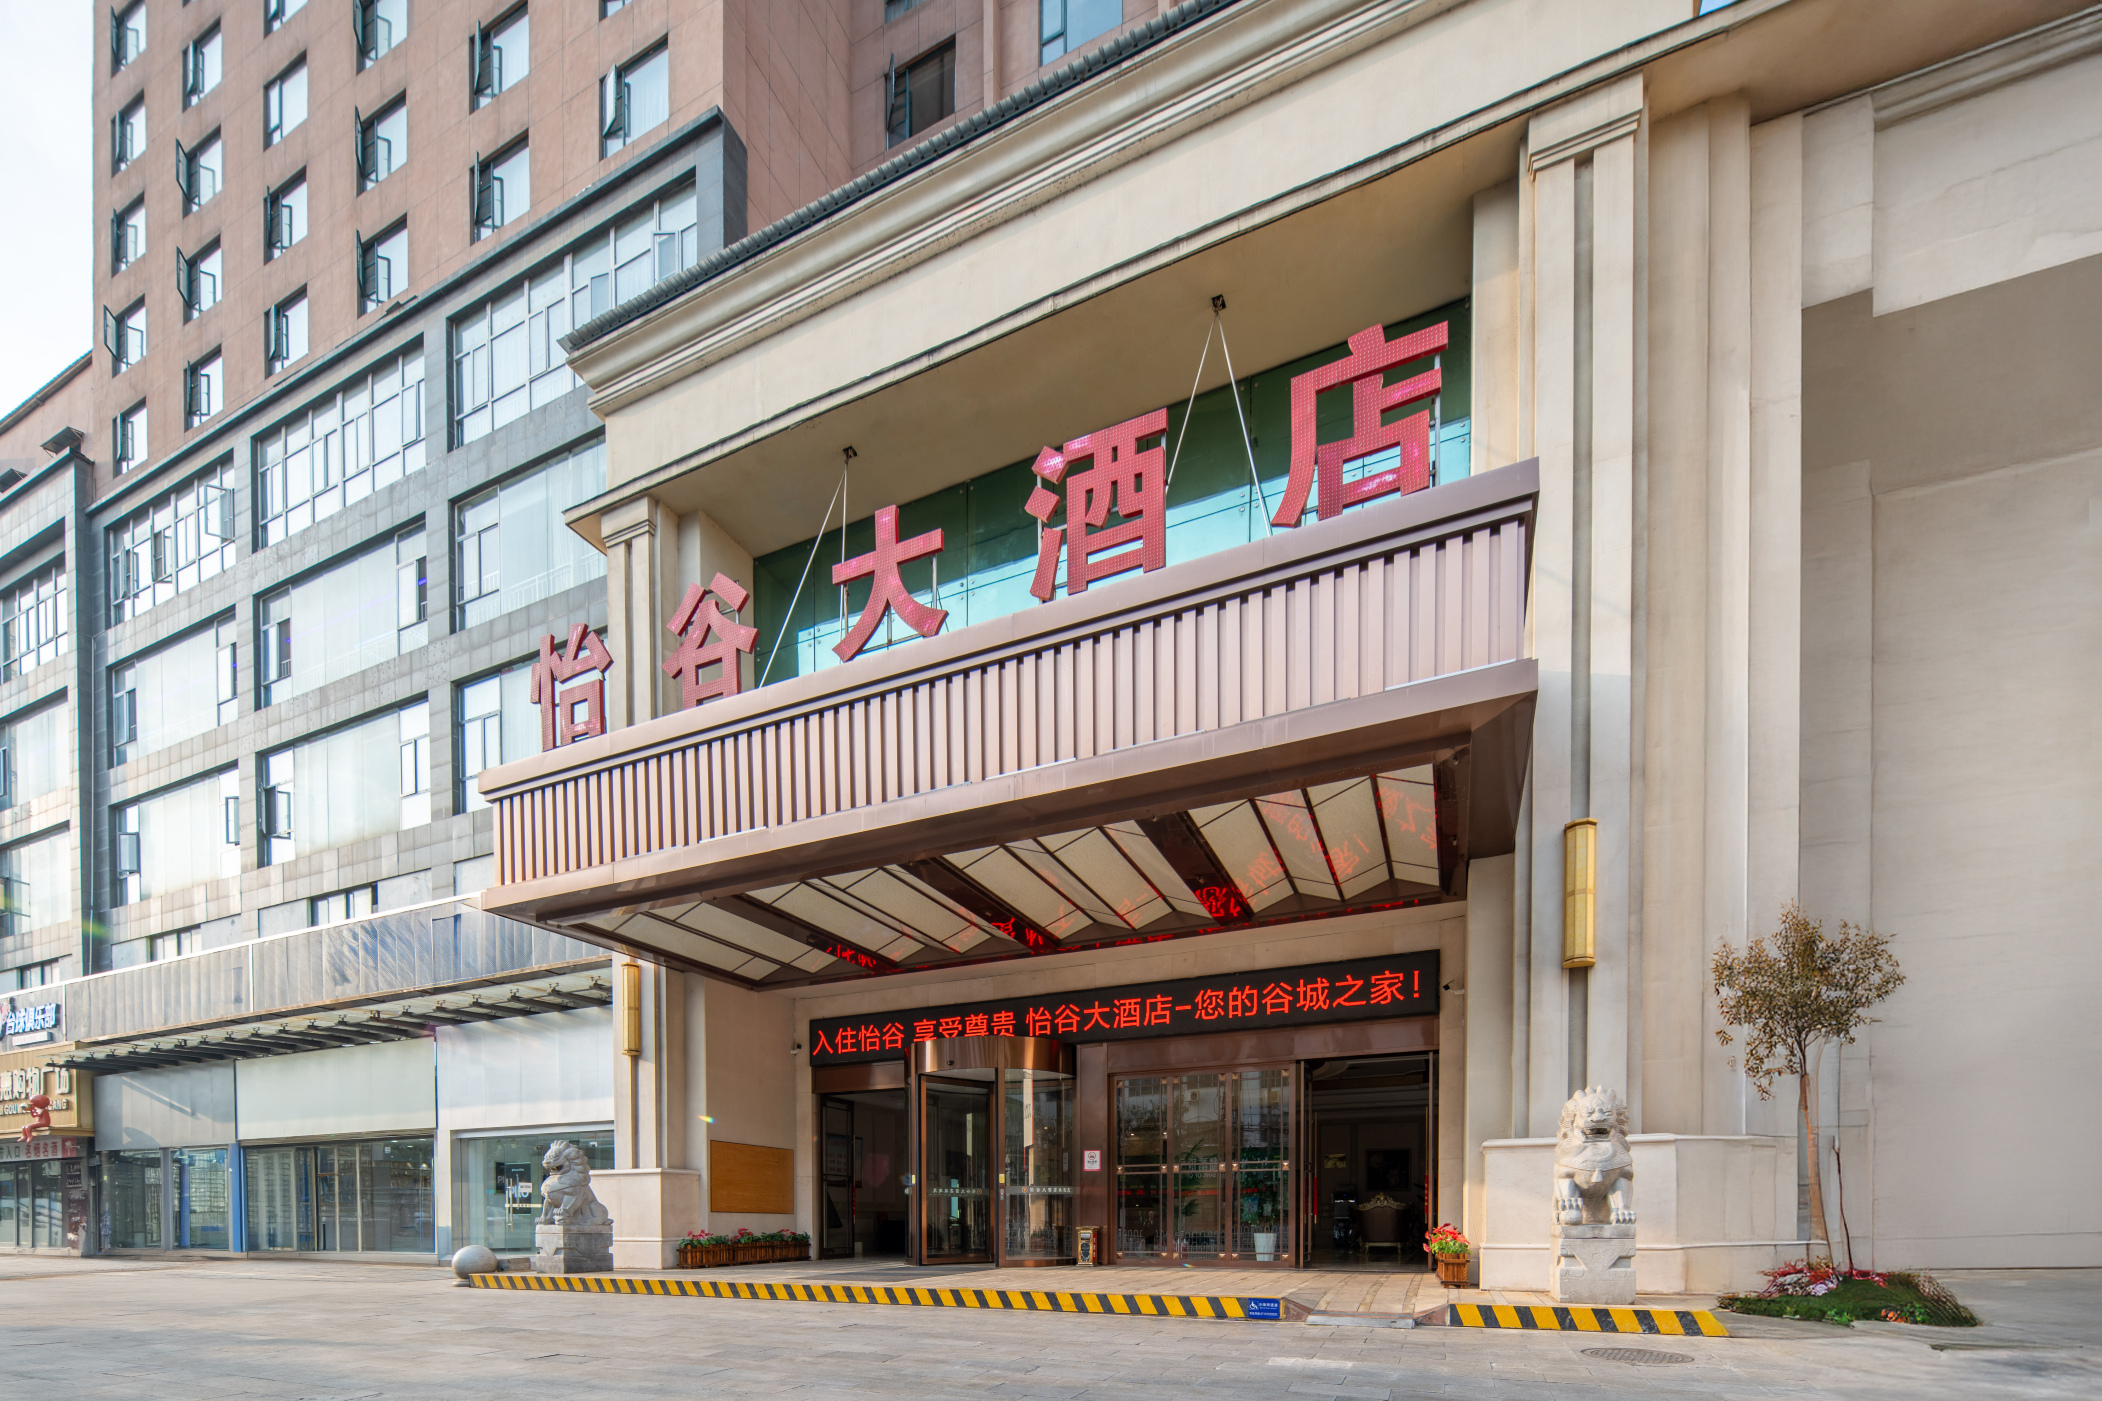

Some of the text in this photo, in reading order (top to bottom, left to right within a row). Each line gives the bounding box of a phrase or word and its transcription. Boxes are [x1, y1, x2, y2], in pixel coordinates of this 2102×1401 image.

[530, 320, 1449, 751] 怡谷大酒店
[812, 1021, 905, 1056] 入住怡谷
[913, 1010, 1016, 1042] 享受尊贵
[25, 1141, 59, 1159] 名烟名酒
